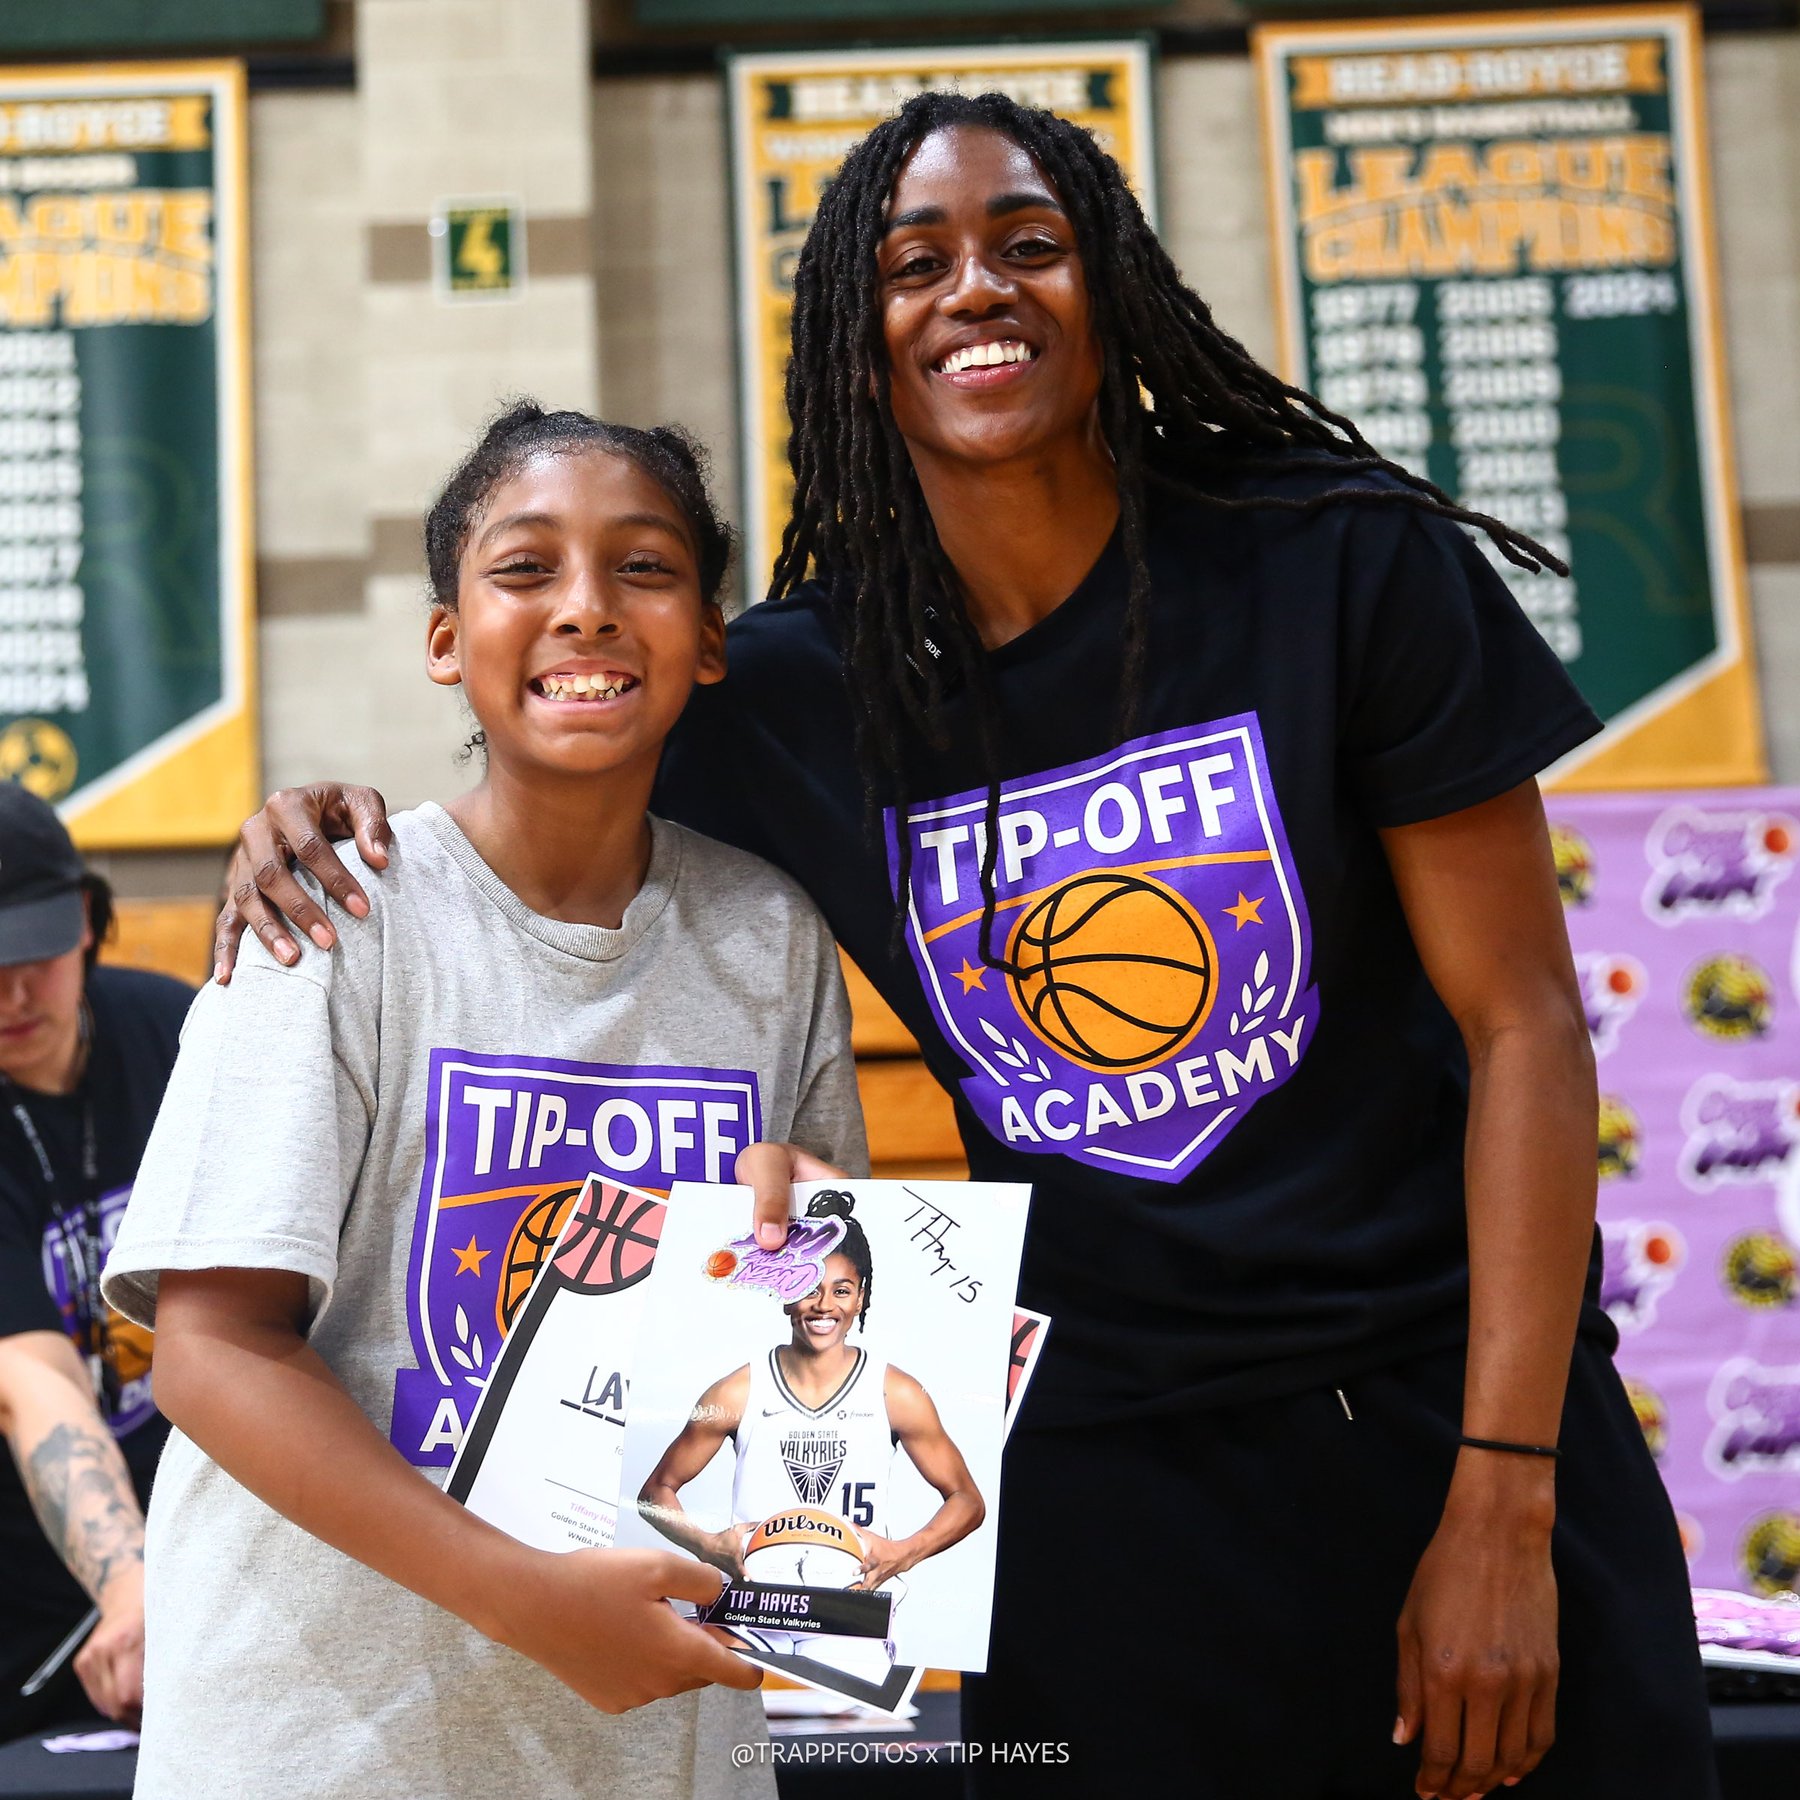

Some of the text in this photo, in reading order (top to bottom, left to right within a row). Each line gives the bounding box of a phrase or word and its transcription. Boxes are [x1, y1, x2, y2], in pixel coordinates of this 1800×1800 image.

[1331, 43, 1628, 97] HEAD-ROYCE
[1297, 134, 1673, 218] LEAGUE
[459, 214, 502, 284] 4
[1304, 197, 1676, 281] CHAMPIONS
[919, 752, 1237, 906] TIP-OFF
[1000, 1014, 1306, 1144] ACADEMY
[463, 1085, 739, 1183] TIP-OFF
[780, 1440, 847, 1465] VALKYRIES
[788, 1430, 838, 1439] GOLDEN STATE
[551, 1511, 578, 1526] Golden
[579, 1522, 600, 1535] State
[764, 1515, 843, 1541] Wilson
[842, 1482, 876, 1527] 15
[725, 1612, 822, 1629] Golden State Valkyries
[730, 1590, 811, 1614] TIP HAYES
